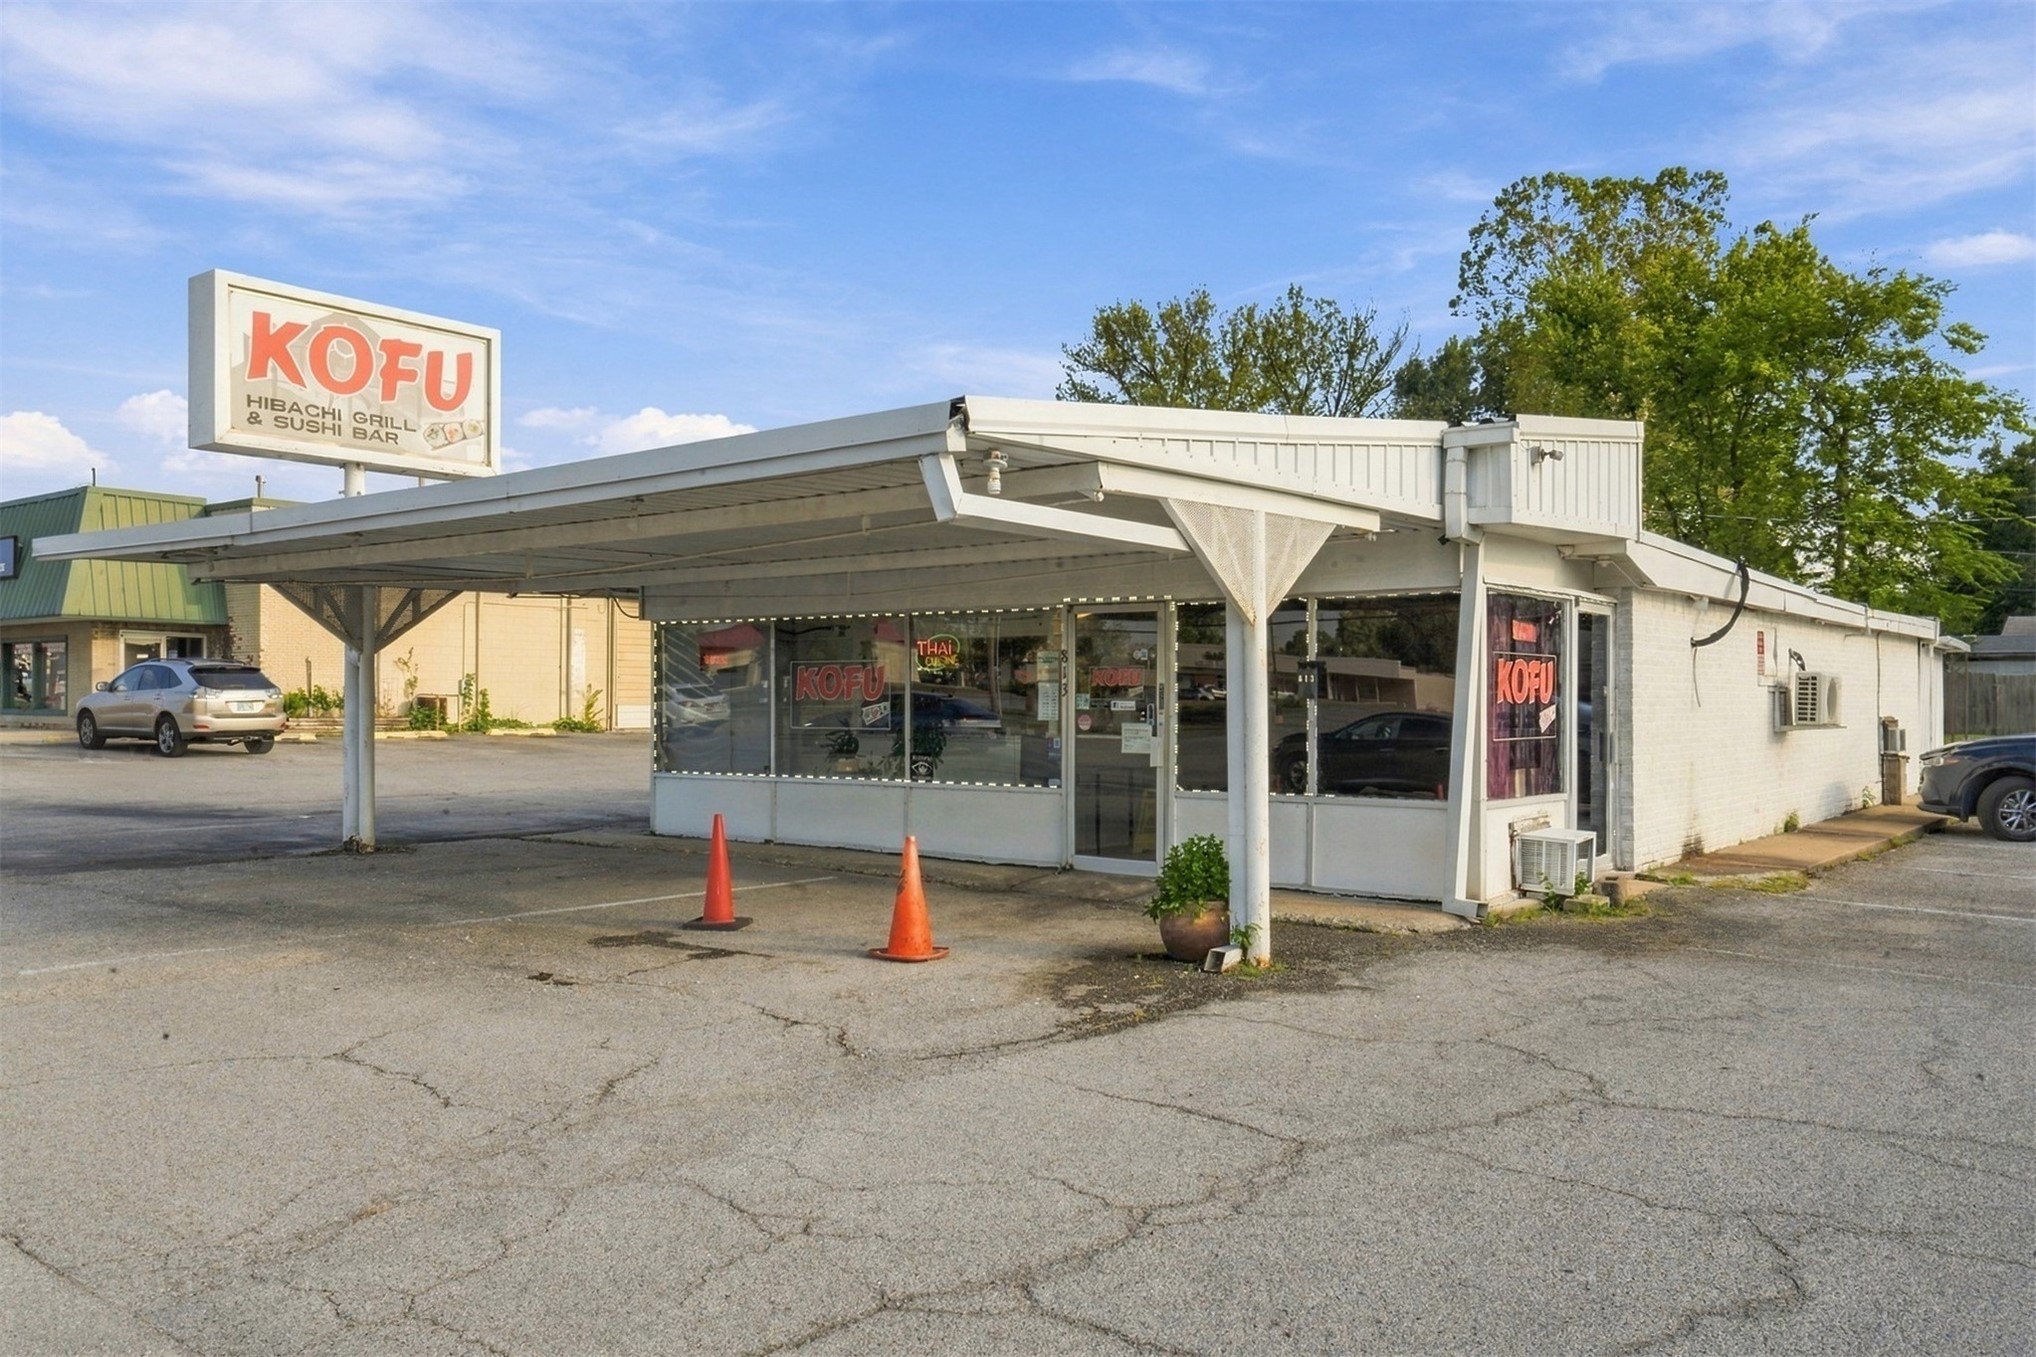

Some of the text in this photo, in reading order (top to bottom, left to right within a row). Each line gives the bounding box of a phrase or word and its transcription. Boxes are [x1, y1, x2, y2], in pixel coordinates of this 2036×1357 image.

[246, 310, 474, 412] KOFU
[246, 394, 417, 433] HIBACHI GRILL
[246, 411, 399, 445] & SUSHI BAR
[795, 664, 885, 701] KOFU
[1092, 667, 1141, 687] KOFU
[1497, 658, 1554, 704] KOFU
